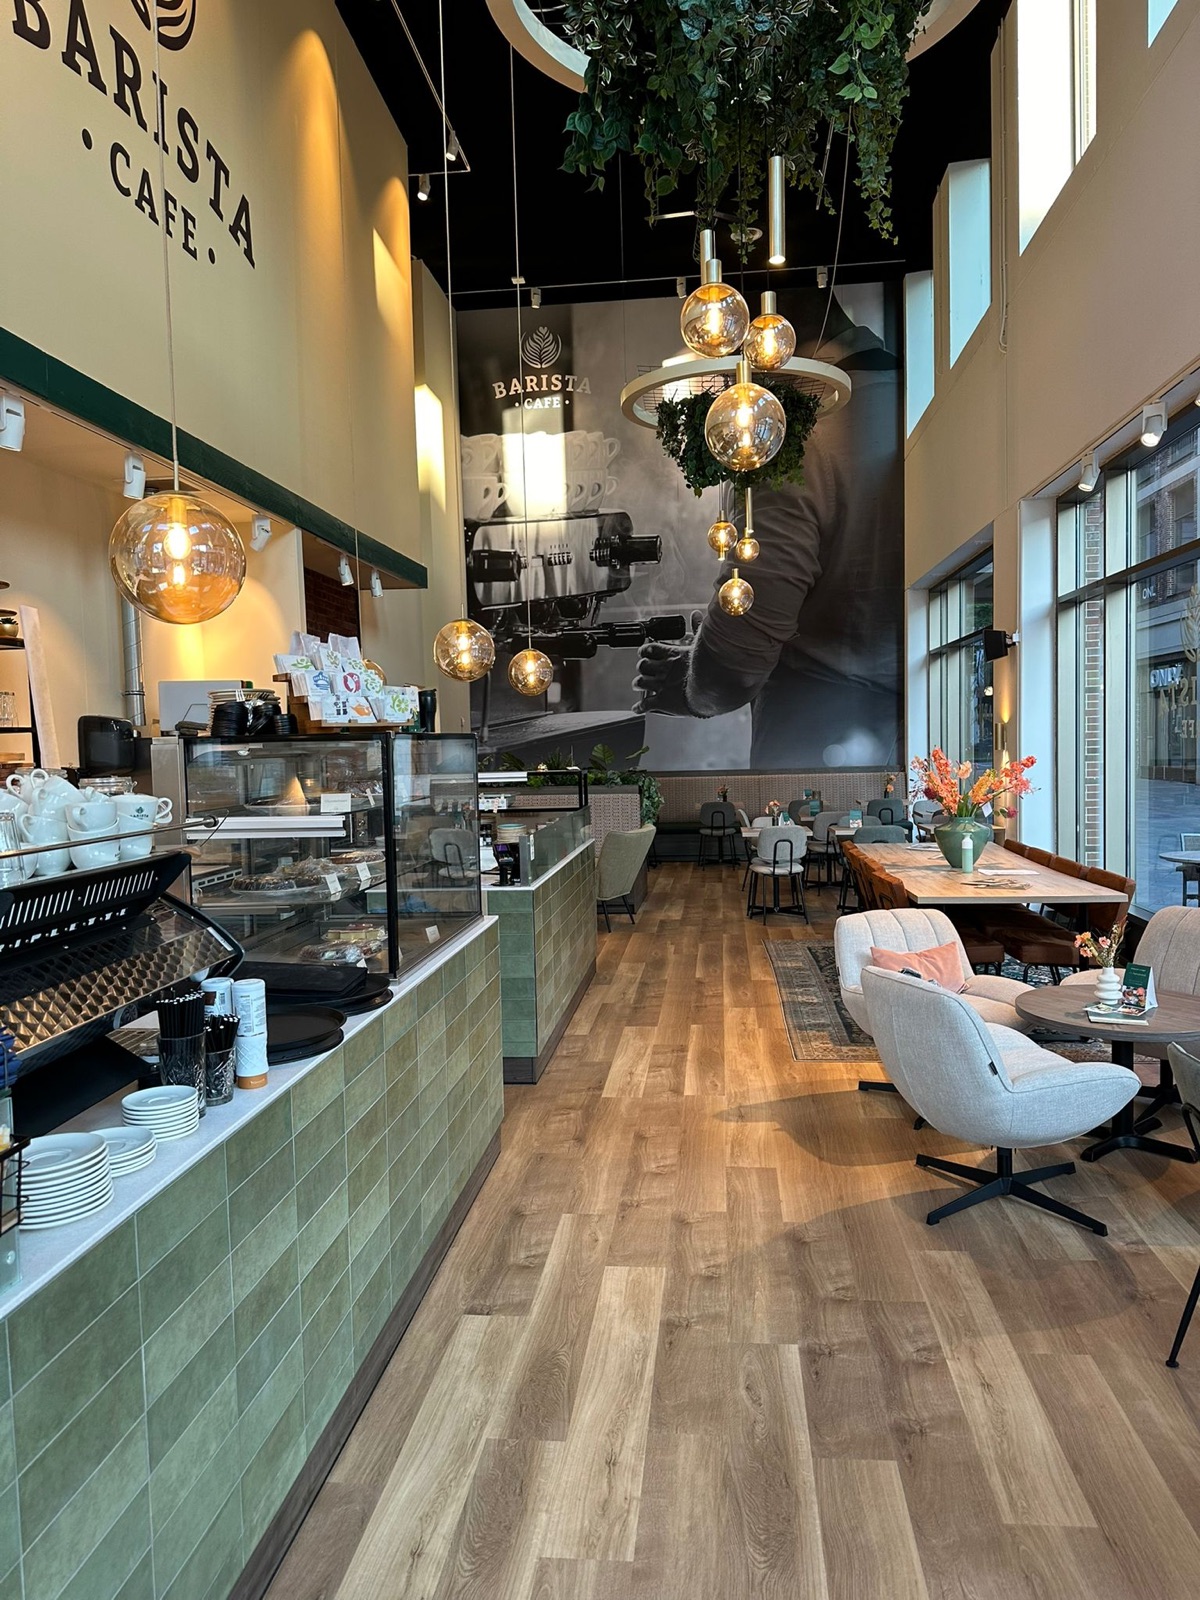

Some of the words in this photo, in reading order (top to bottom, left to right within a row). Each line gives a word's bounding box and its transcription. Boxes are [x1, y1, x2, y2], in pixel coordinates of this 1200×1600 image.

[110, 142, 197, 261] CAFE
[492, 374, 592, 399] BARISTA
[524, 397, 561, 409] CAFE
